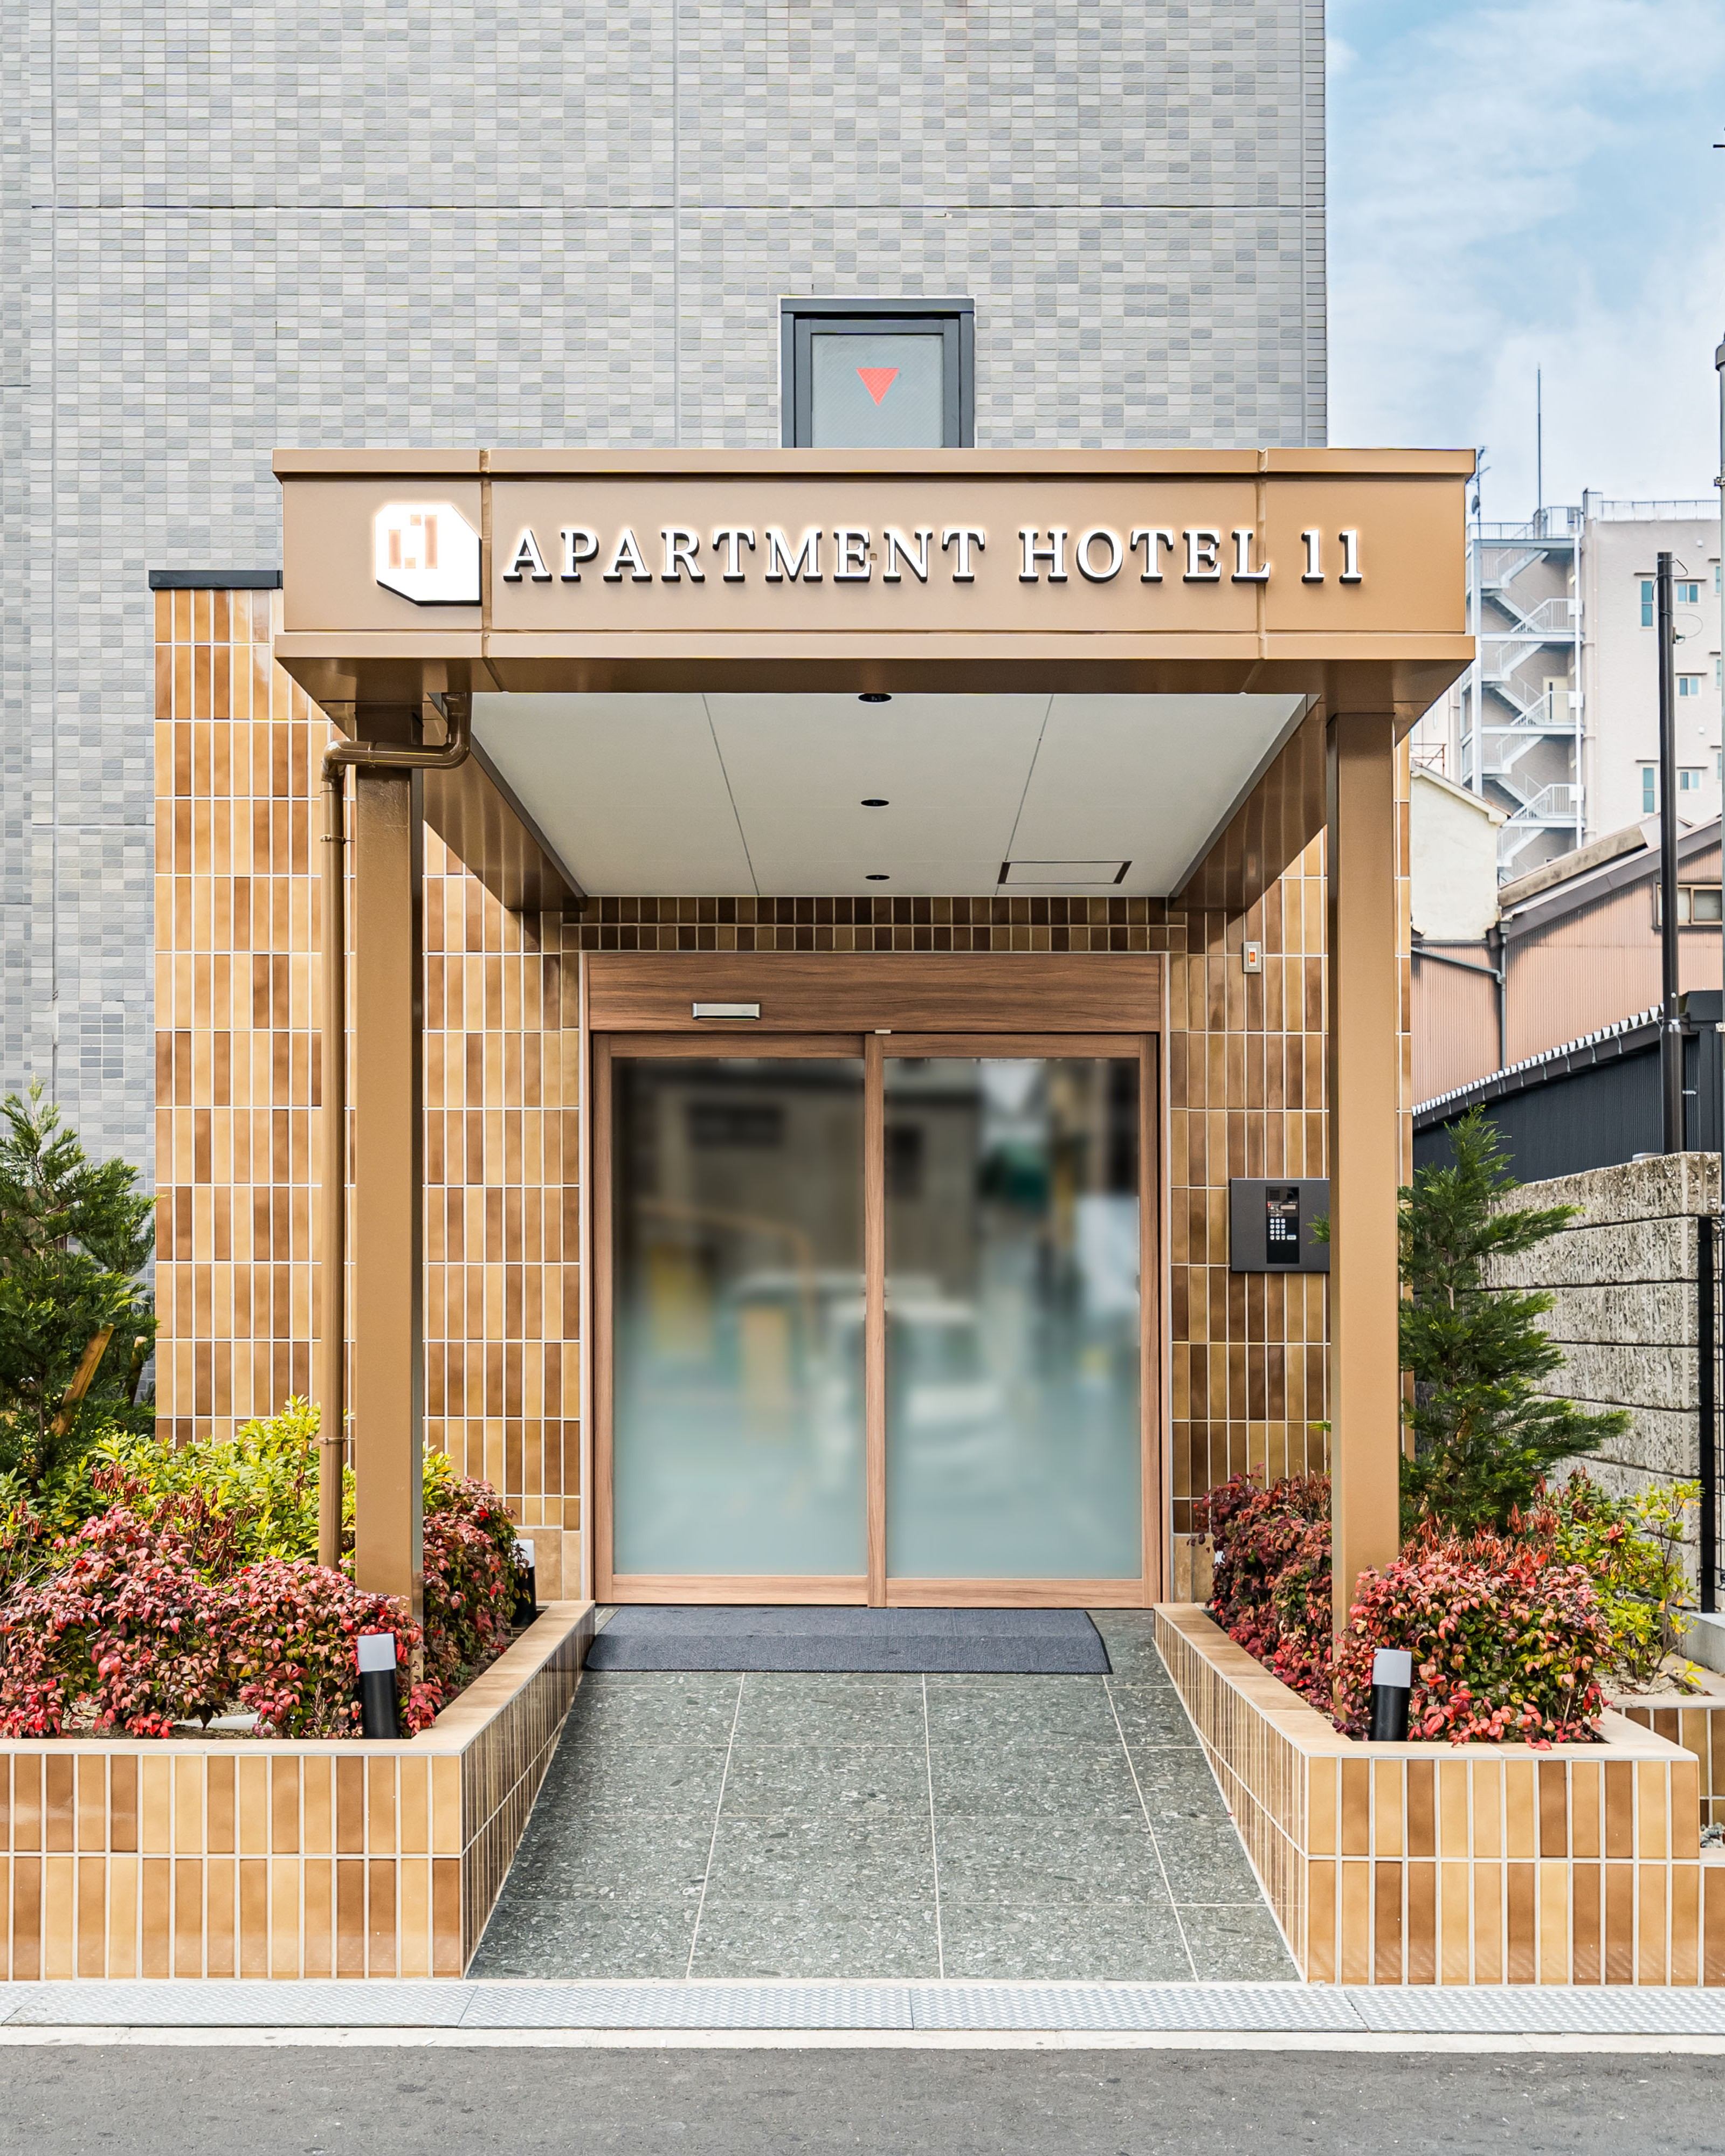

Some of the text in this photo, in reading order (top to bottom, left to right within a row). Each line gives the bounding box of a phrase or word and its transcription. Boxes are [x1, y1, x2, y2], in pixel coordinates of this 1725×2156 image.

[502, 528, 1363, 584] APARTMENT HOTEL 11
